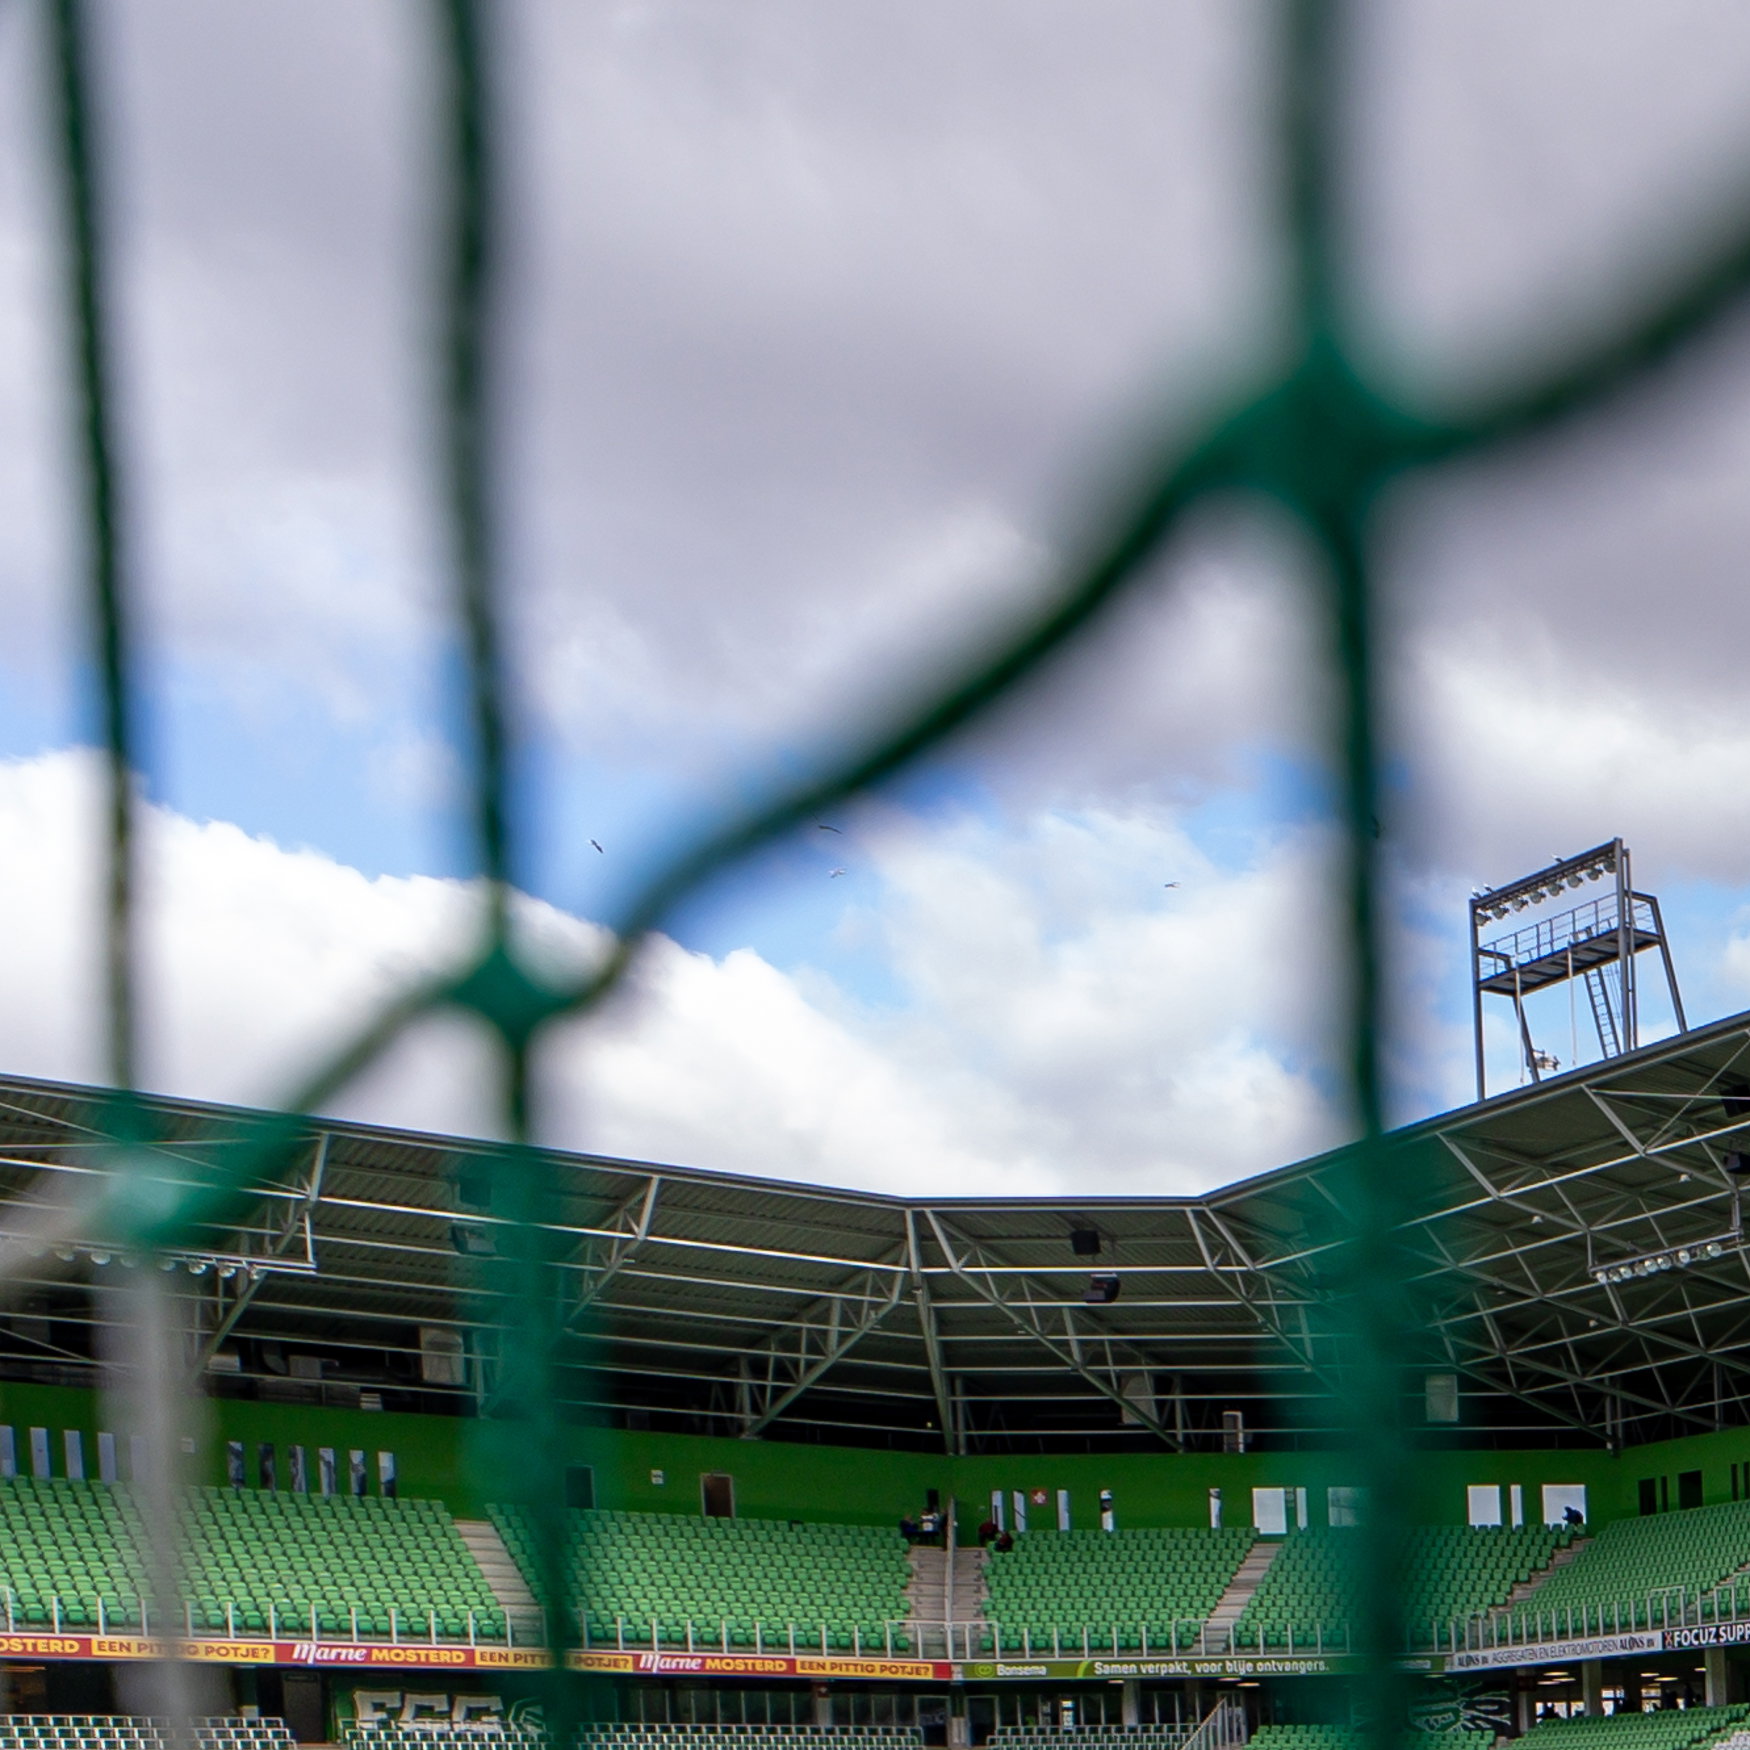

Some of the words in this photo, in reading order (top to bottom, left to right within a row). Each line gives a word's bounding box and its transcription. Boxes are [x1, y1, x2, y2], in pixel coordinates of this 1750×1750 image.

[1673, 1626, 1717, 1647] FOCUZ
[97, 1640, 131, 1653] EEN
[205, 1645, 270, 1660] POTJE?
[292, 1643, 367, 1664] Marne
[371, 1649, 466, 1664] MOSTERD
[479, 1651, 509, 1663] EEN
[574, 1656, 629, 1669] POTJE?
[639, 1653, 702, 1674] Marne
[705, 1658, 788, 1672] MOSTERD
[800, 1662, 826, 1672] EEN
[830, 1662, 875, 1674] PITTIG
[879, 1664, 930, 1677] POTJE?
[1094, 1661, 1138, 1674] Samen
[1140, 1661, 1191, 1676] verpakt,
[1195, 1661, 1222, 1673] voor
[1256, 1659, 1329, 1675] ontvangers.
